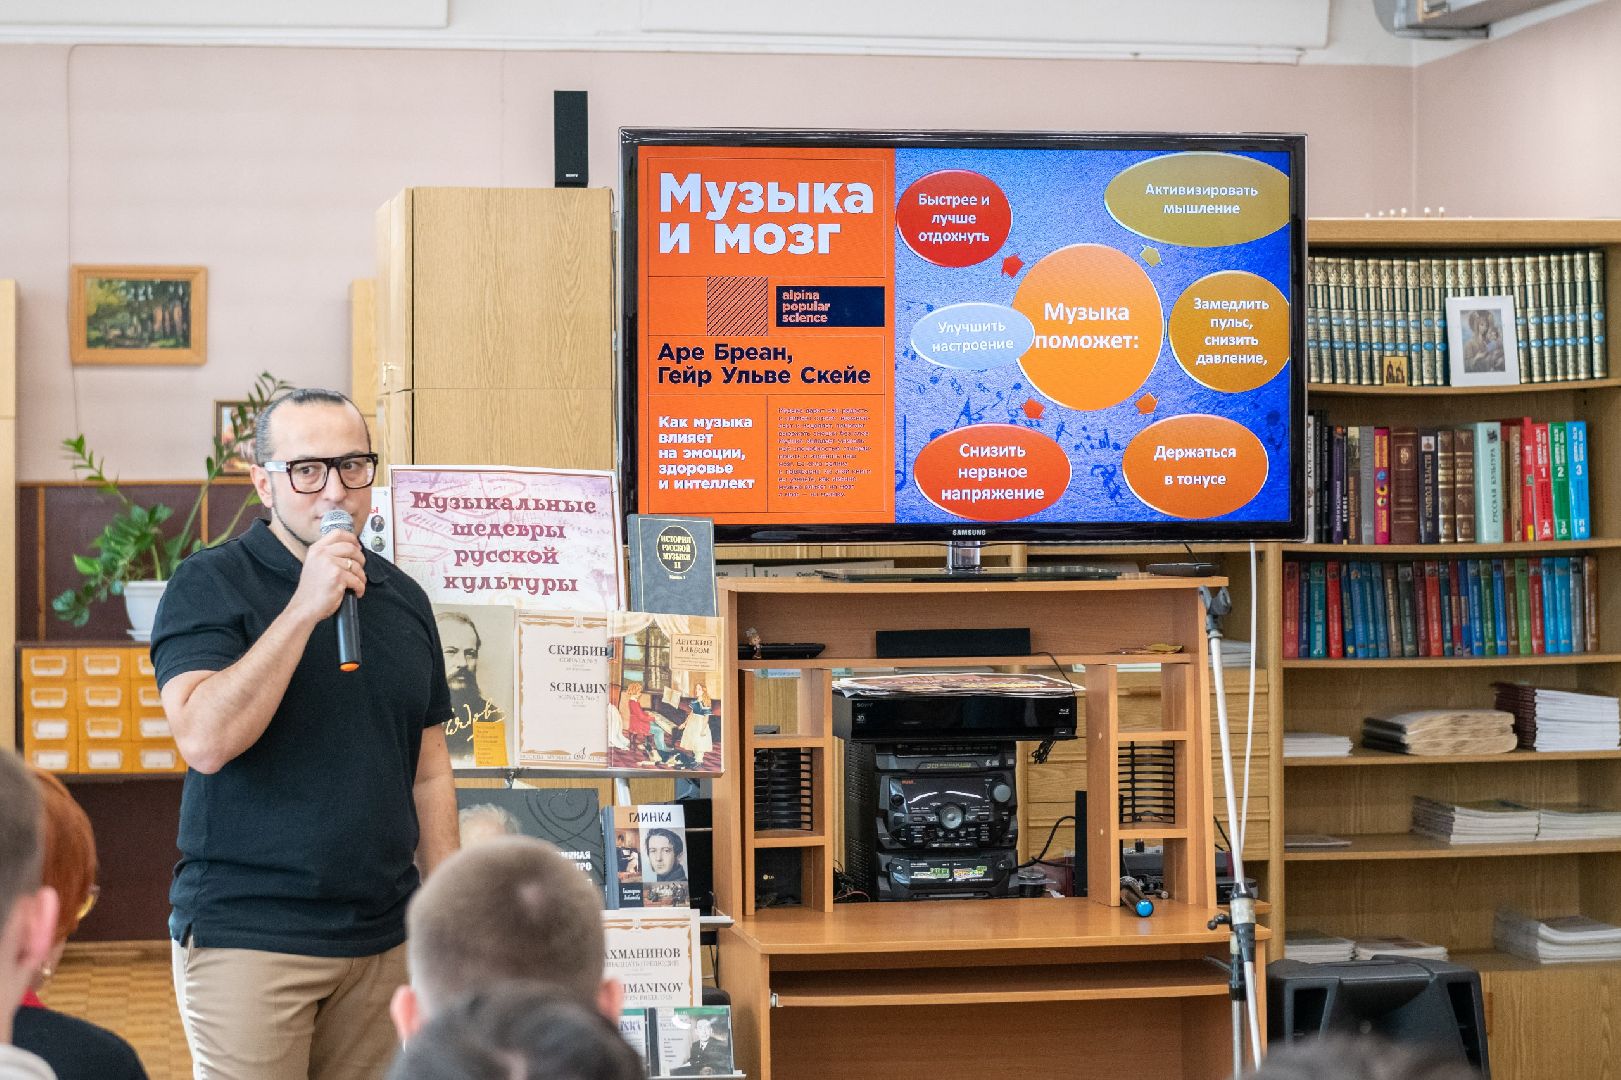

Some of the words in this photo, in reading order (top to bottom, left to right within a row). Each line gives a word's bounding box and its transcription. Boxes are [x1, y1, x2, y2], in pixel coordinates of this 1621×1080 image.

[660, 172, 874, 221] Музыка
[1145, 184, 1258, 199] Активизировать
[918, 193, 978, 208] Быстрее
[981, 196, 990, 206] и
[1163, 203, 1240, 214] мышление
[931, 213, 976, 228] лучше
[659, 222, 690, 254] и
[714, 222, 841, 255] мозг
[918, 231, 990, 245] отдохнуть
[782, 290, 820, 302] alpina
[782, 301, 830, 313] popular
[1193, 298, 1269, 312] Замедлить
[782, 312, 828, 323] science
[1044, 303, 1130, 325] Музыка
[938, 320, 1006, 335] Улучшить
[1210, 317, 1254, 331] пульс,
[932, 338, 1014, 354] настроение
[1035, 332, 1139, 351] поможет:
[1204, 334, 1259, 347] снизить
[658, 343, 704, 364] Аре
[714, 343, 793, 364] Бреан,
[1195, 352, 1268, 366] давление,
[658, 366, 712, 388] Гейр
[722, 366, 791, 384] Ульве
[800, 365, 871, 384] Скейе
[658, 416, 689, 428] Как
[693, 418, 753, 431] музыка
[658, 434, 714, 444] влияет
[658, 449, 678, 460] на
[683, 449, 746, 461] эмоции,
[959, 444, 1026, 458] Снизить
[1153, 445, 1237, 462] Держаться
[658, 464, 734, 476] здоровье
[958, 466, 1028, 480] нервное
[1558, 467, 1564, 477] 2
[1576, 465, 1582, 476] 3
[658, 480, 669, 490] и
[674, 480, 755, 490] интеллект
[1164, 475, 1172, 485] в
[1176, 474, 1226, 488] тонусе
[941, 487, 1045, 503] напряжение
[410, 491, 597, 514] Музыкальные
[451, 523, 567, 541] шедевры
[661, 536, 692, 544] ИСТОРИЯ
[662, 544, 690, 552] РУССКОЙ
[454, 547, 559, 567] русской
[443, 576, 579, 596] культуры
[549, 645, 608, 656] СКРЯБИН
[550, 682, 607, 693] SCRIABIN
[629, 812, 672, 823] ГЛИНКА
